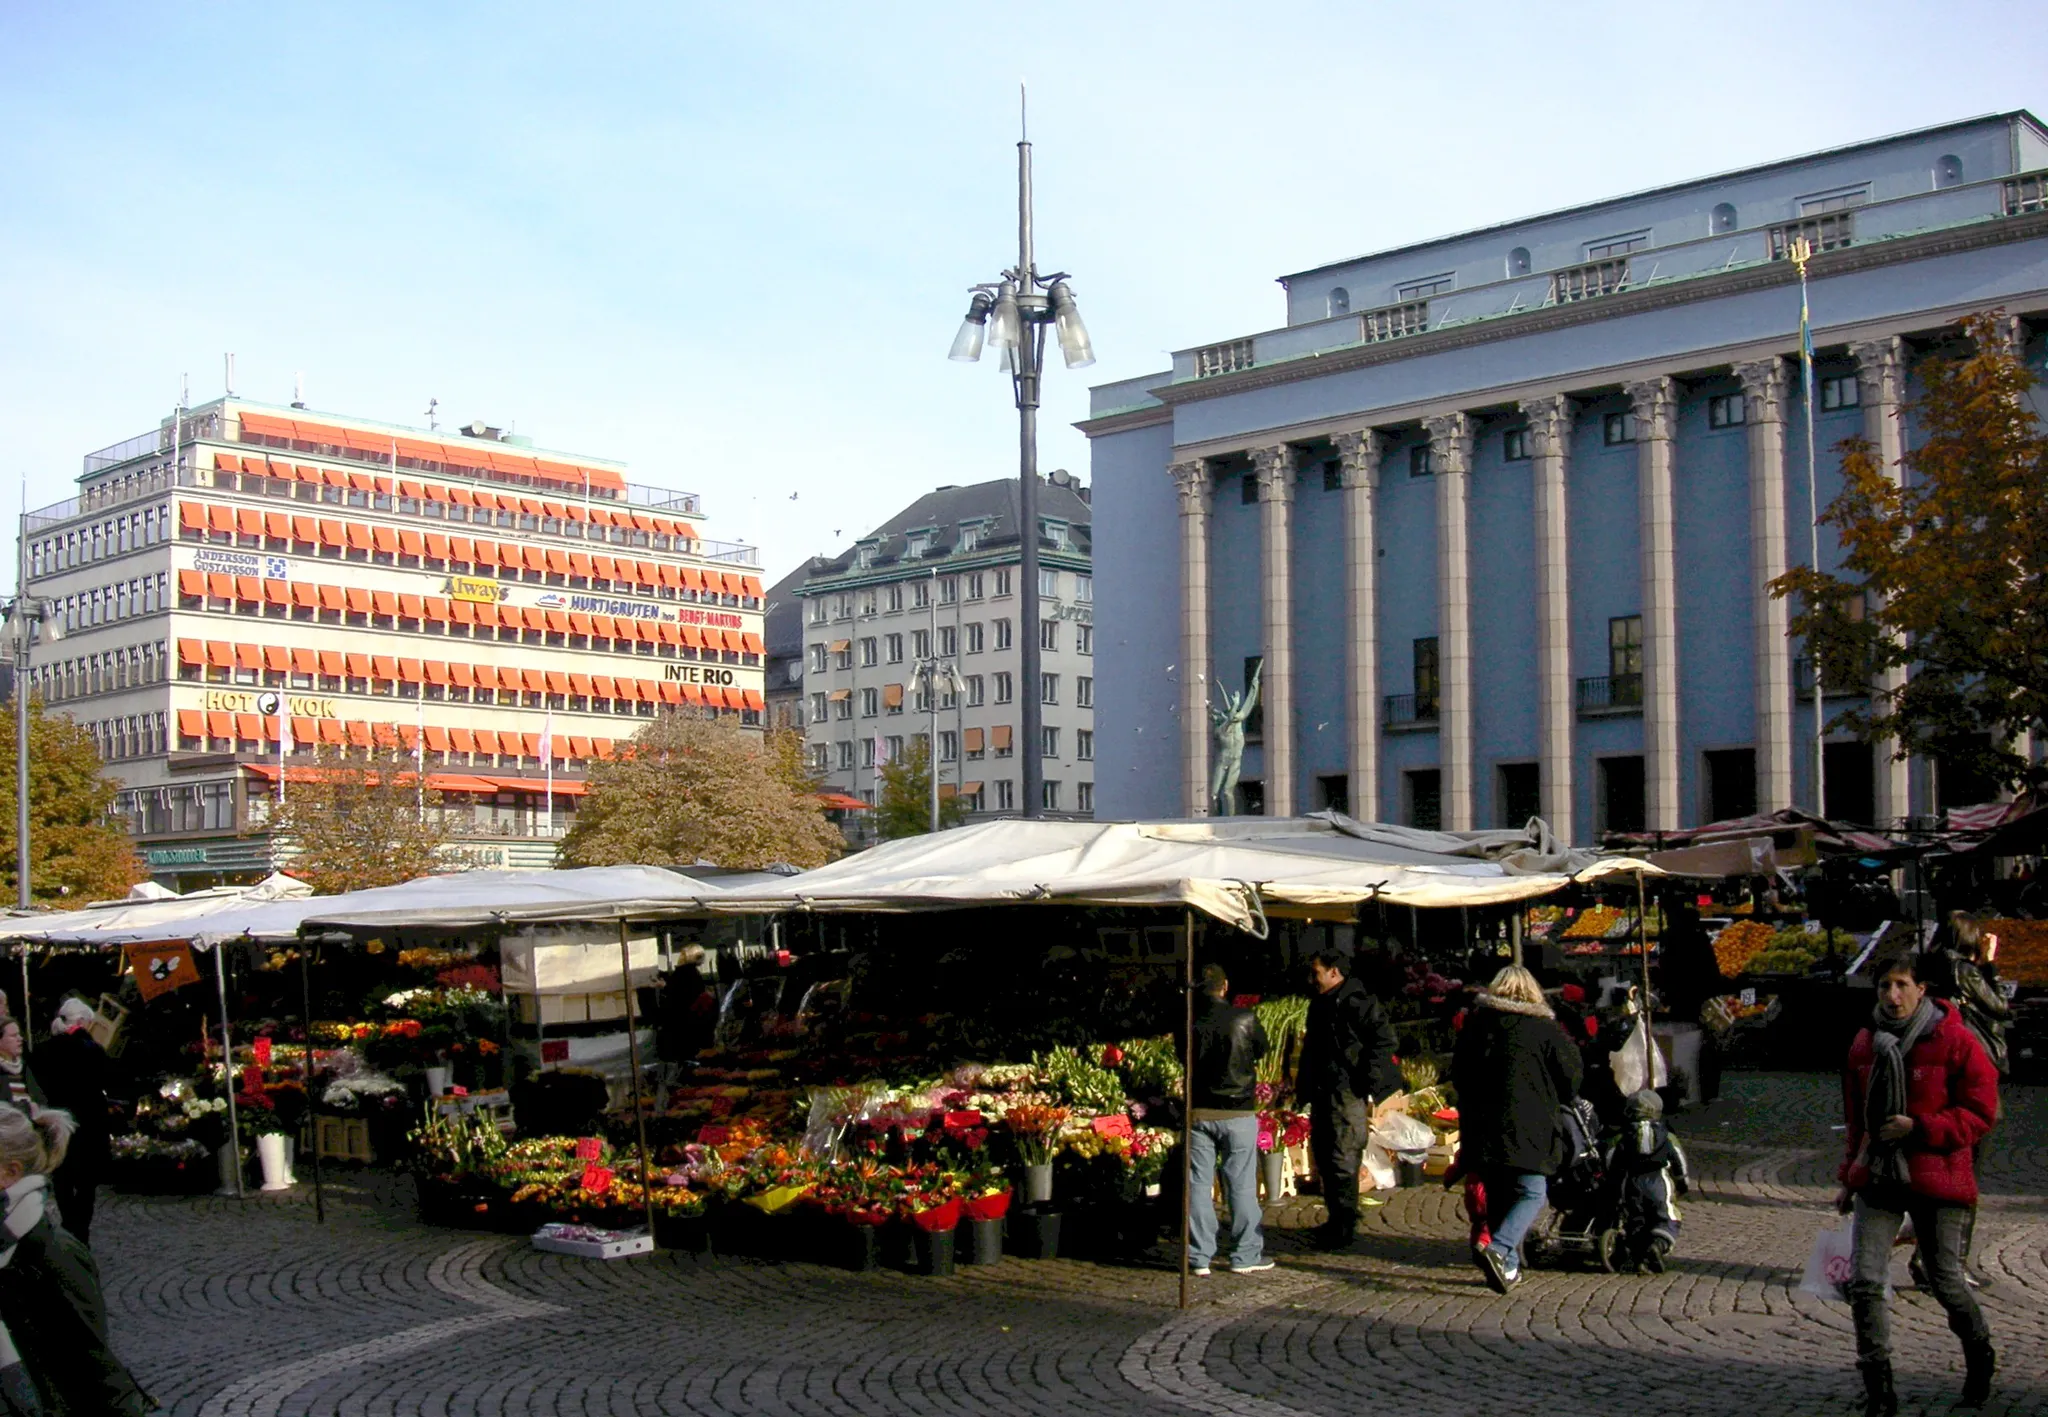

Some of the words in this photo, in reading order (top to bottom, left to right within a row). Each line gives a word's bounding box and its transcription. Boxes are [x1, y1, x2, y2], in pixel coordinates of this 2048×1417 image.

[193, 559, 259, 576] GUSTAFSSON
[194, 548, 259, 566] ANDERSSON
[439, 577, 511, 602] Always
[570, 595, 660, 619] HURTIGRUTEN
[1050, 602, 1093, 623] SUPER
[206, 690, 252, 712] HOT
[289, 697, 336, 718] WOK
